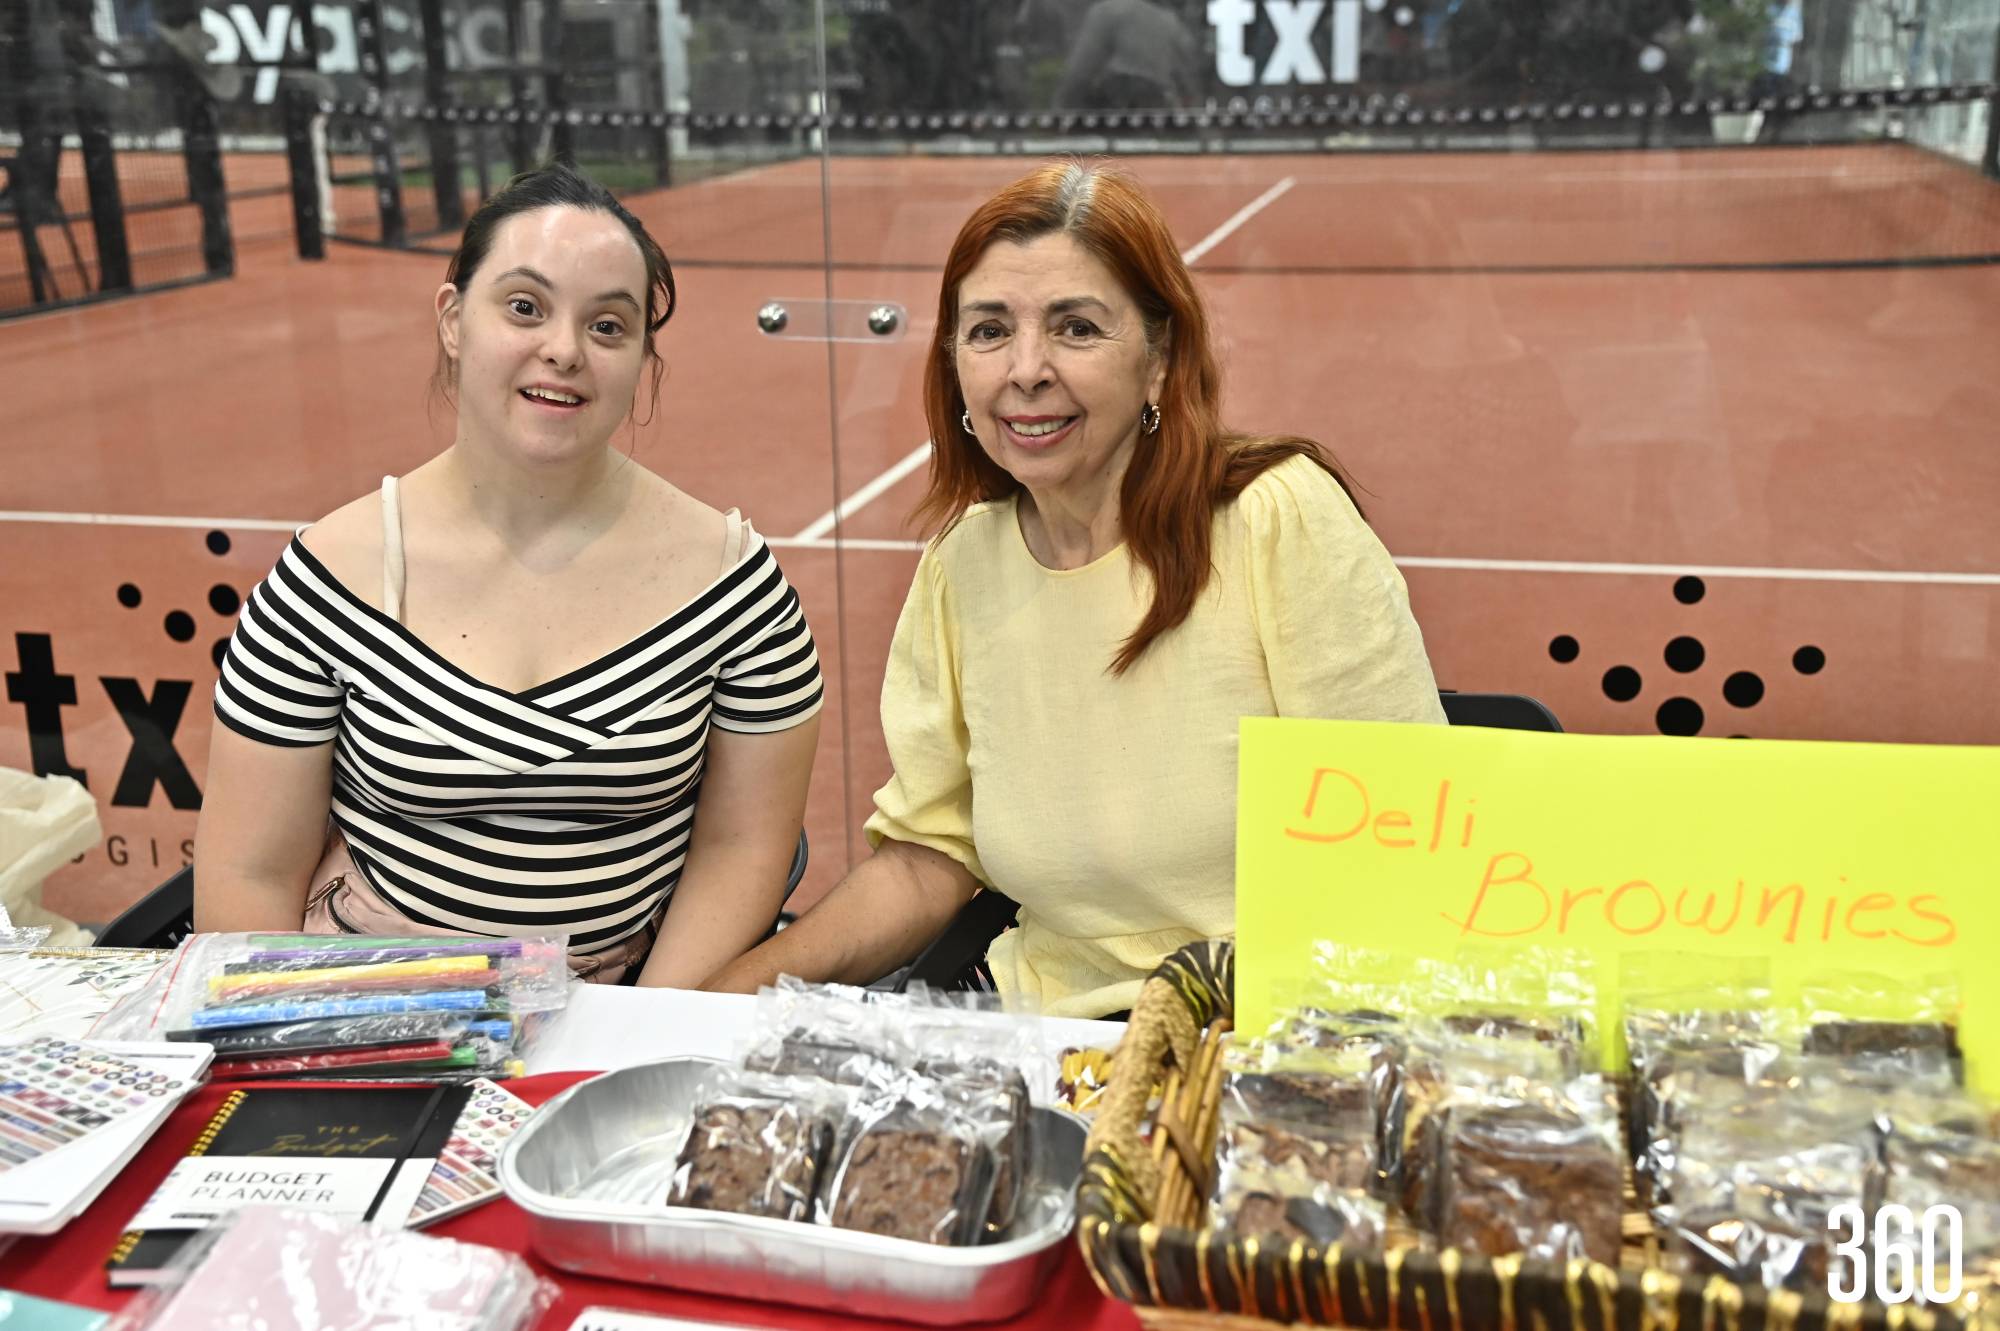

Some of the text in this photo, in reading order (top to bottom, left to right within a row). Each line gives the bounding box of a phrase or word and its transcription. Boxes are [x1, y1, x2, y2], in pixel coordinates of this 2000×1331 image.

[4, 631, 205, 811] tx
[1284, 767, 1478, 853] Deli
[71, 834, 195, 869] GIS
[1440, 851, 1958, 947] Brownies
[316, 1125, 361, 1135] THE
[190, 1187, 336, 1203] PLANNER
[203, 1170, 336, 1186] BUDGET
